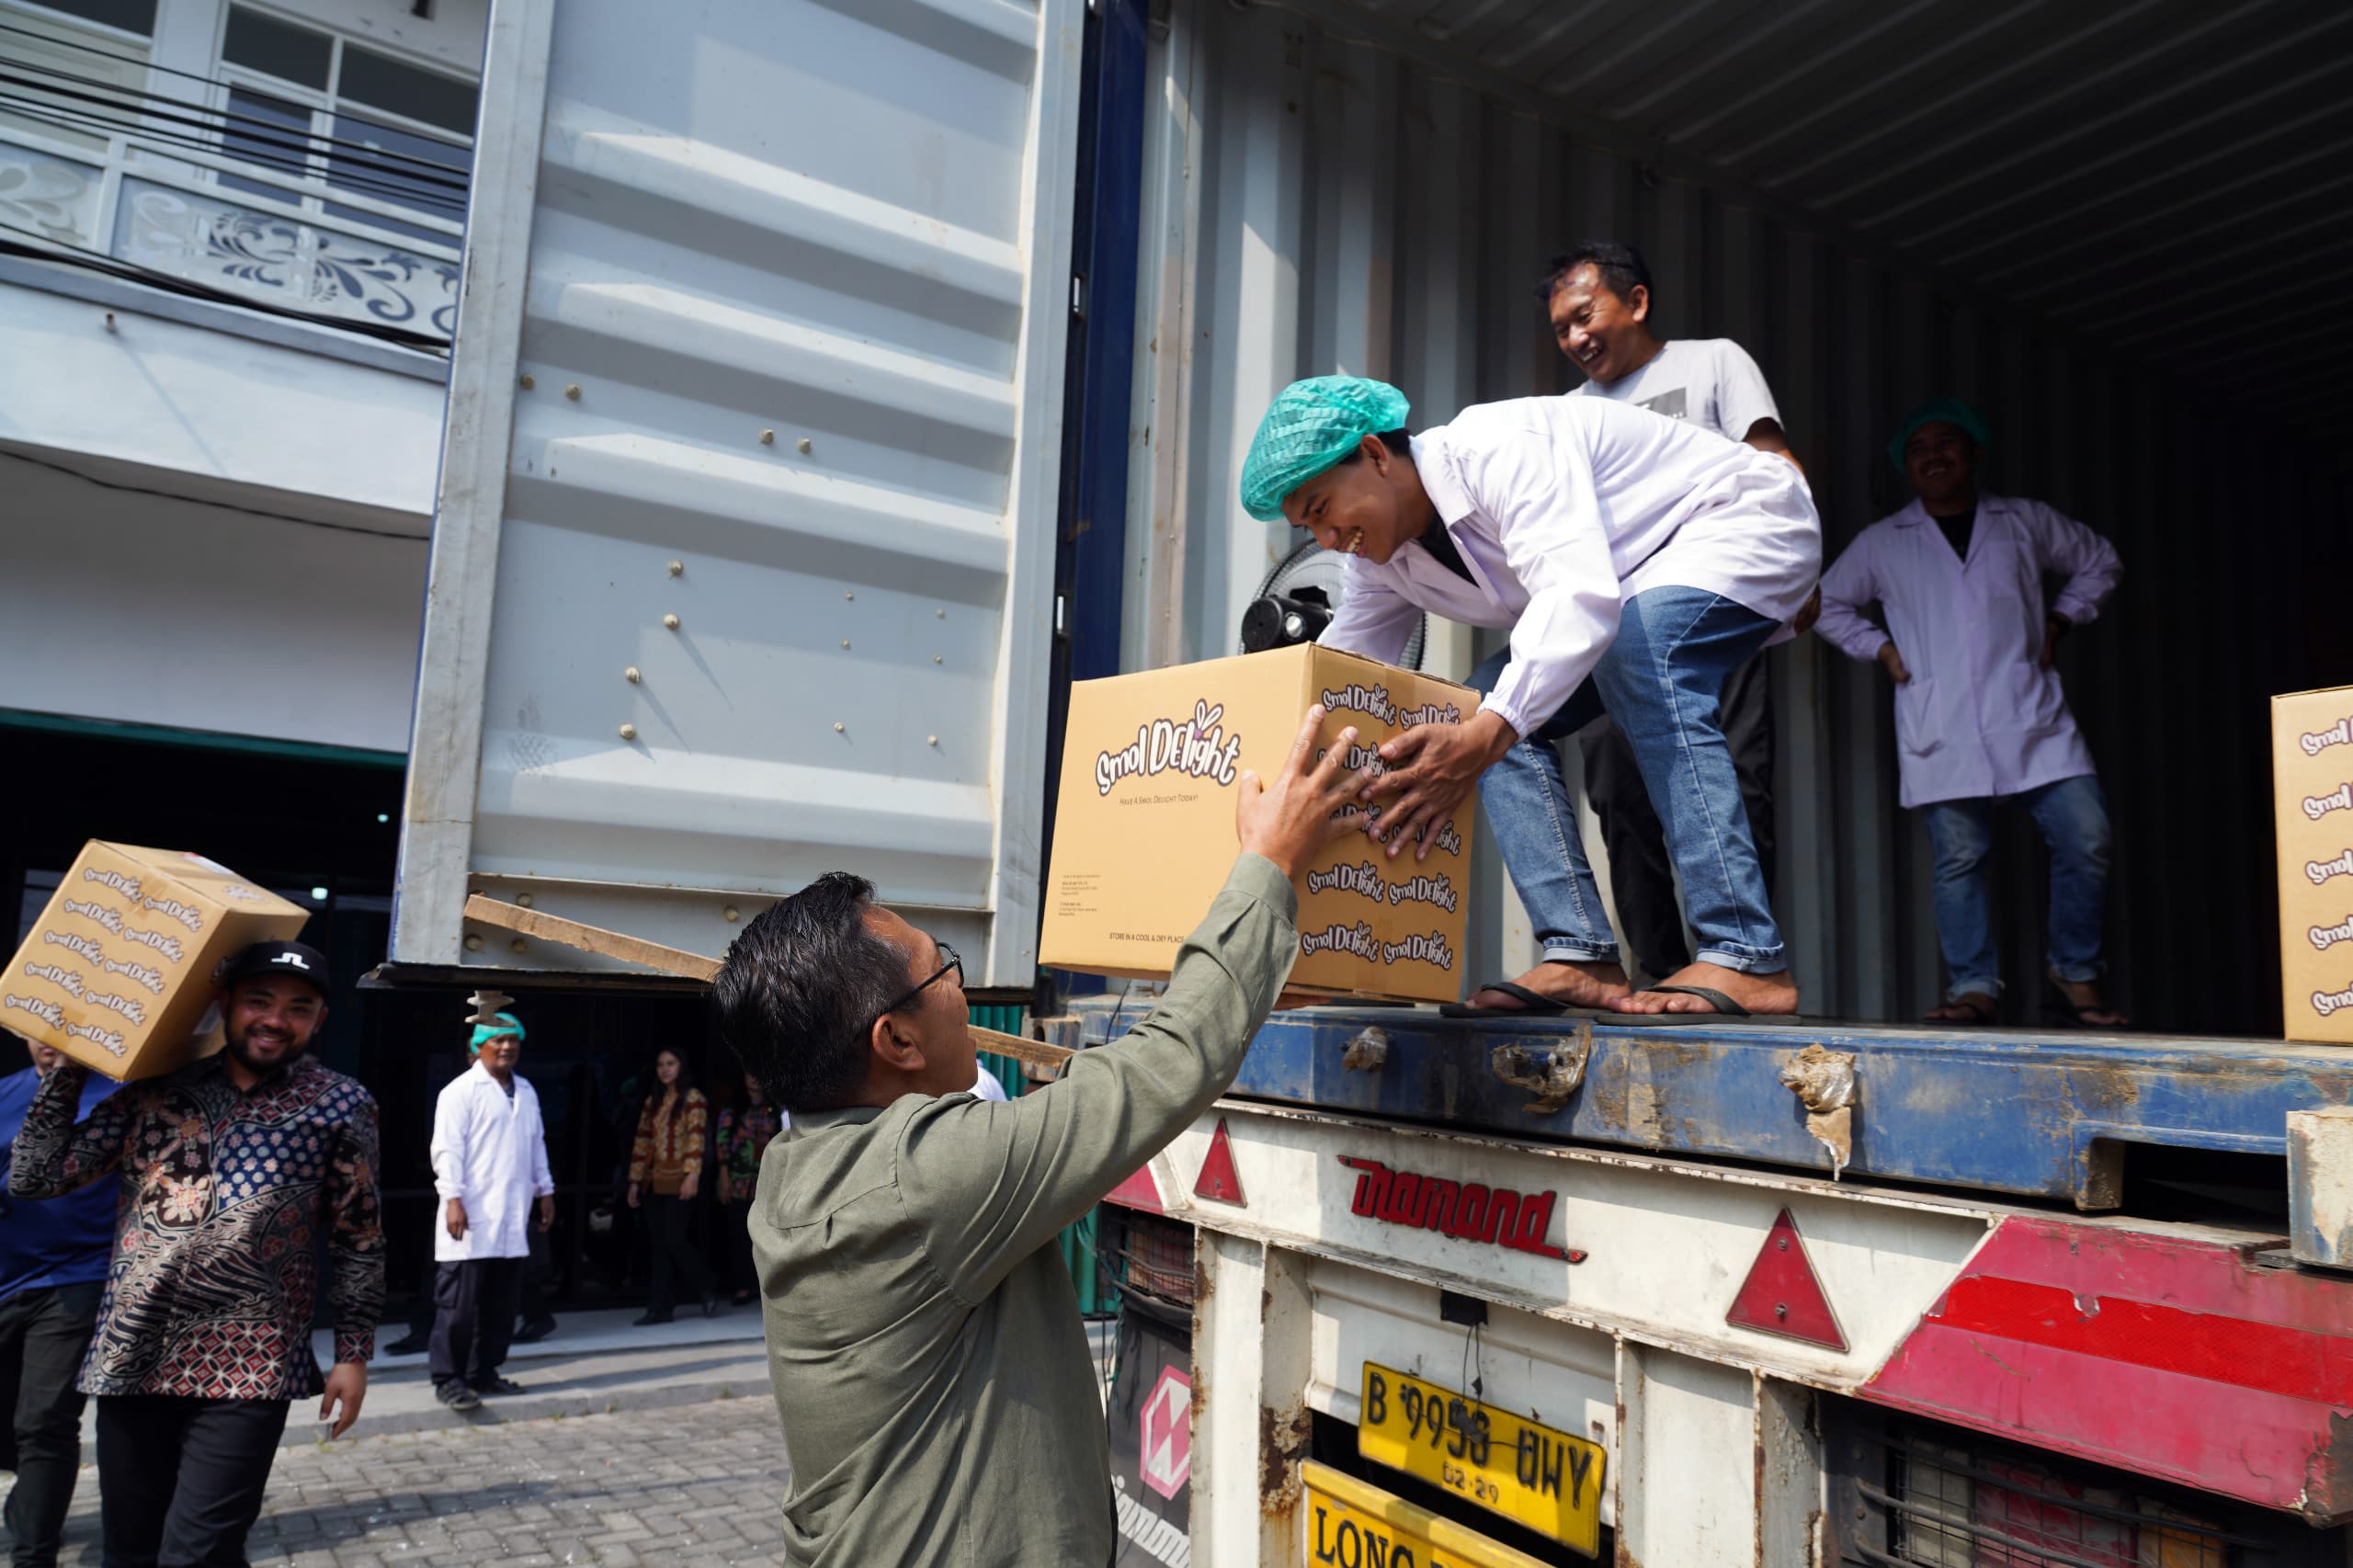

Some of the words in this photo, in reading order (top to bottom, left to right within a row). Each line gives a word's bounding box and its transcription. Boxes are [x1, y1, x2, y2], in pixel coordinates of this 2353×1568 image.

[2301, 718, 2348, 756] Smol
[1096, 724, 1149, 797] Smol
[2302, 783, 2352, 821] Smol
[2305, 847, 2353, 885] Smol
[1136, 933, 1151, 942] COOL
[1156, 934, 1167, 942] DRY
[2312, 982, 2353, 1017] Smo
[1367, 1370, 1387, 1426] B
